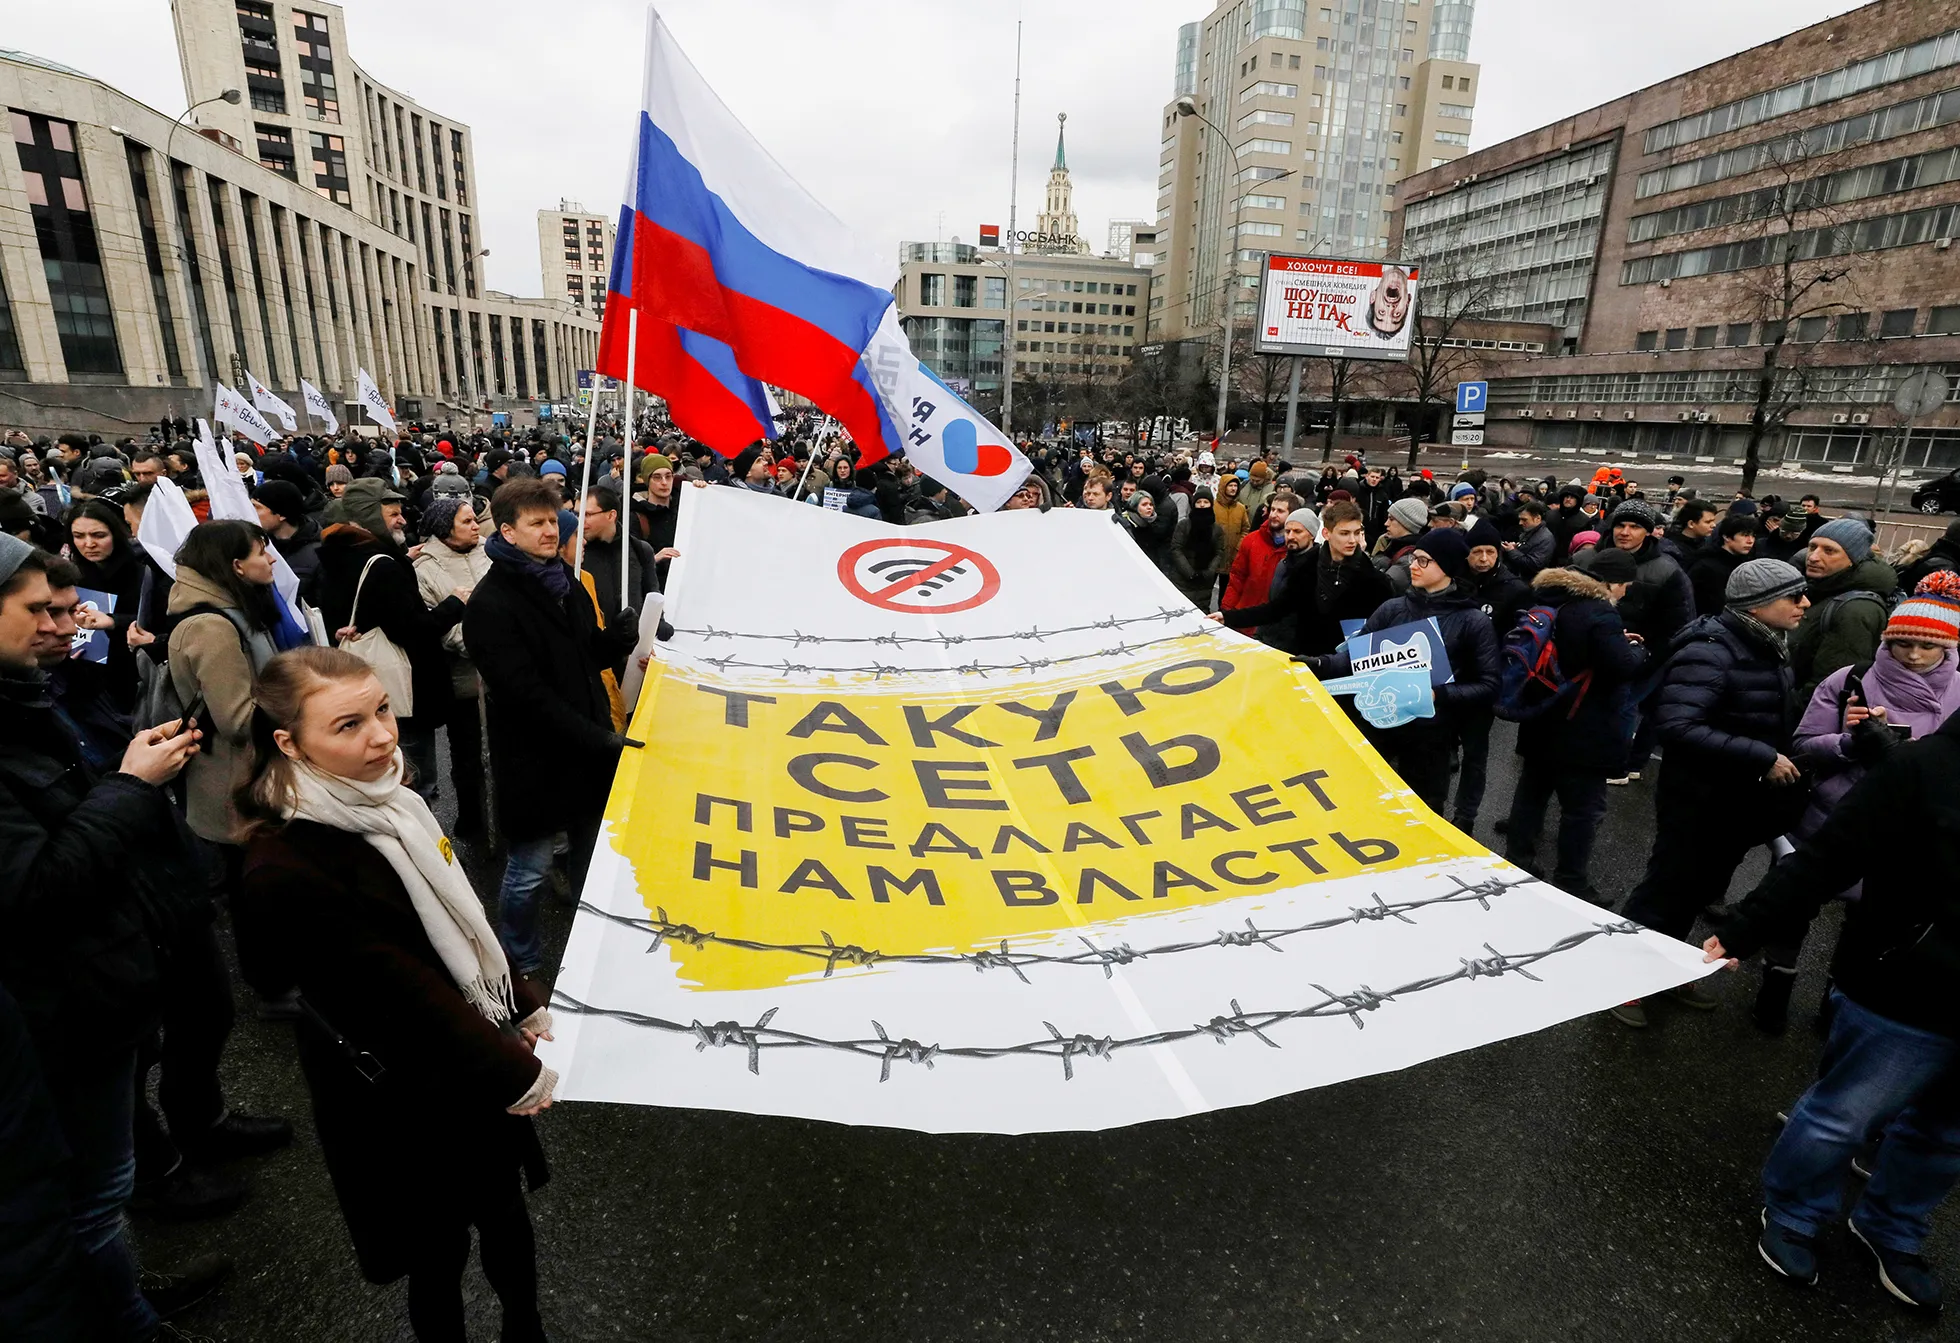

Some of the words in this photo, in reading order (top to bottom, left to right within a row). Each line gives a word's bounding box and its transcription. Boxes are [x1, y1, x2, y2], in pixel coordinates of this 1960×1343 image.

[1007, 230, 1077, 245] РОСБАНК
[1287, 261, 1334, 273] ХОХОЧУТ
[1336, 265, 1358, 275] ВСЕ!
[1284, 287, 1320, 301] ШОУ
[1319, 293, 1357, 304] ПОШЛО
[1294, 278, 1332, 288] СМЕШНАЯ
[1333, 281, 1367, 290] КОМЕДИЯ
[1287, 301, 1314, 320] НЕ
[1317, 302, 1352, 333] ТАК
[1464, 386, 1480, 409] P
[1353, 648, 1418, 673] КЛИШАС
[697, 658, 1235, 748] ТАКУЮ
[786, 733, 1222, 811] СЕТЬ
[694, 769, 1339, 860] ПРЕДЛАГАЕТ
[692, 841, 945, 906] НАМ
[990, 831, 1400, 907] ВЛАСТЬ
